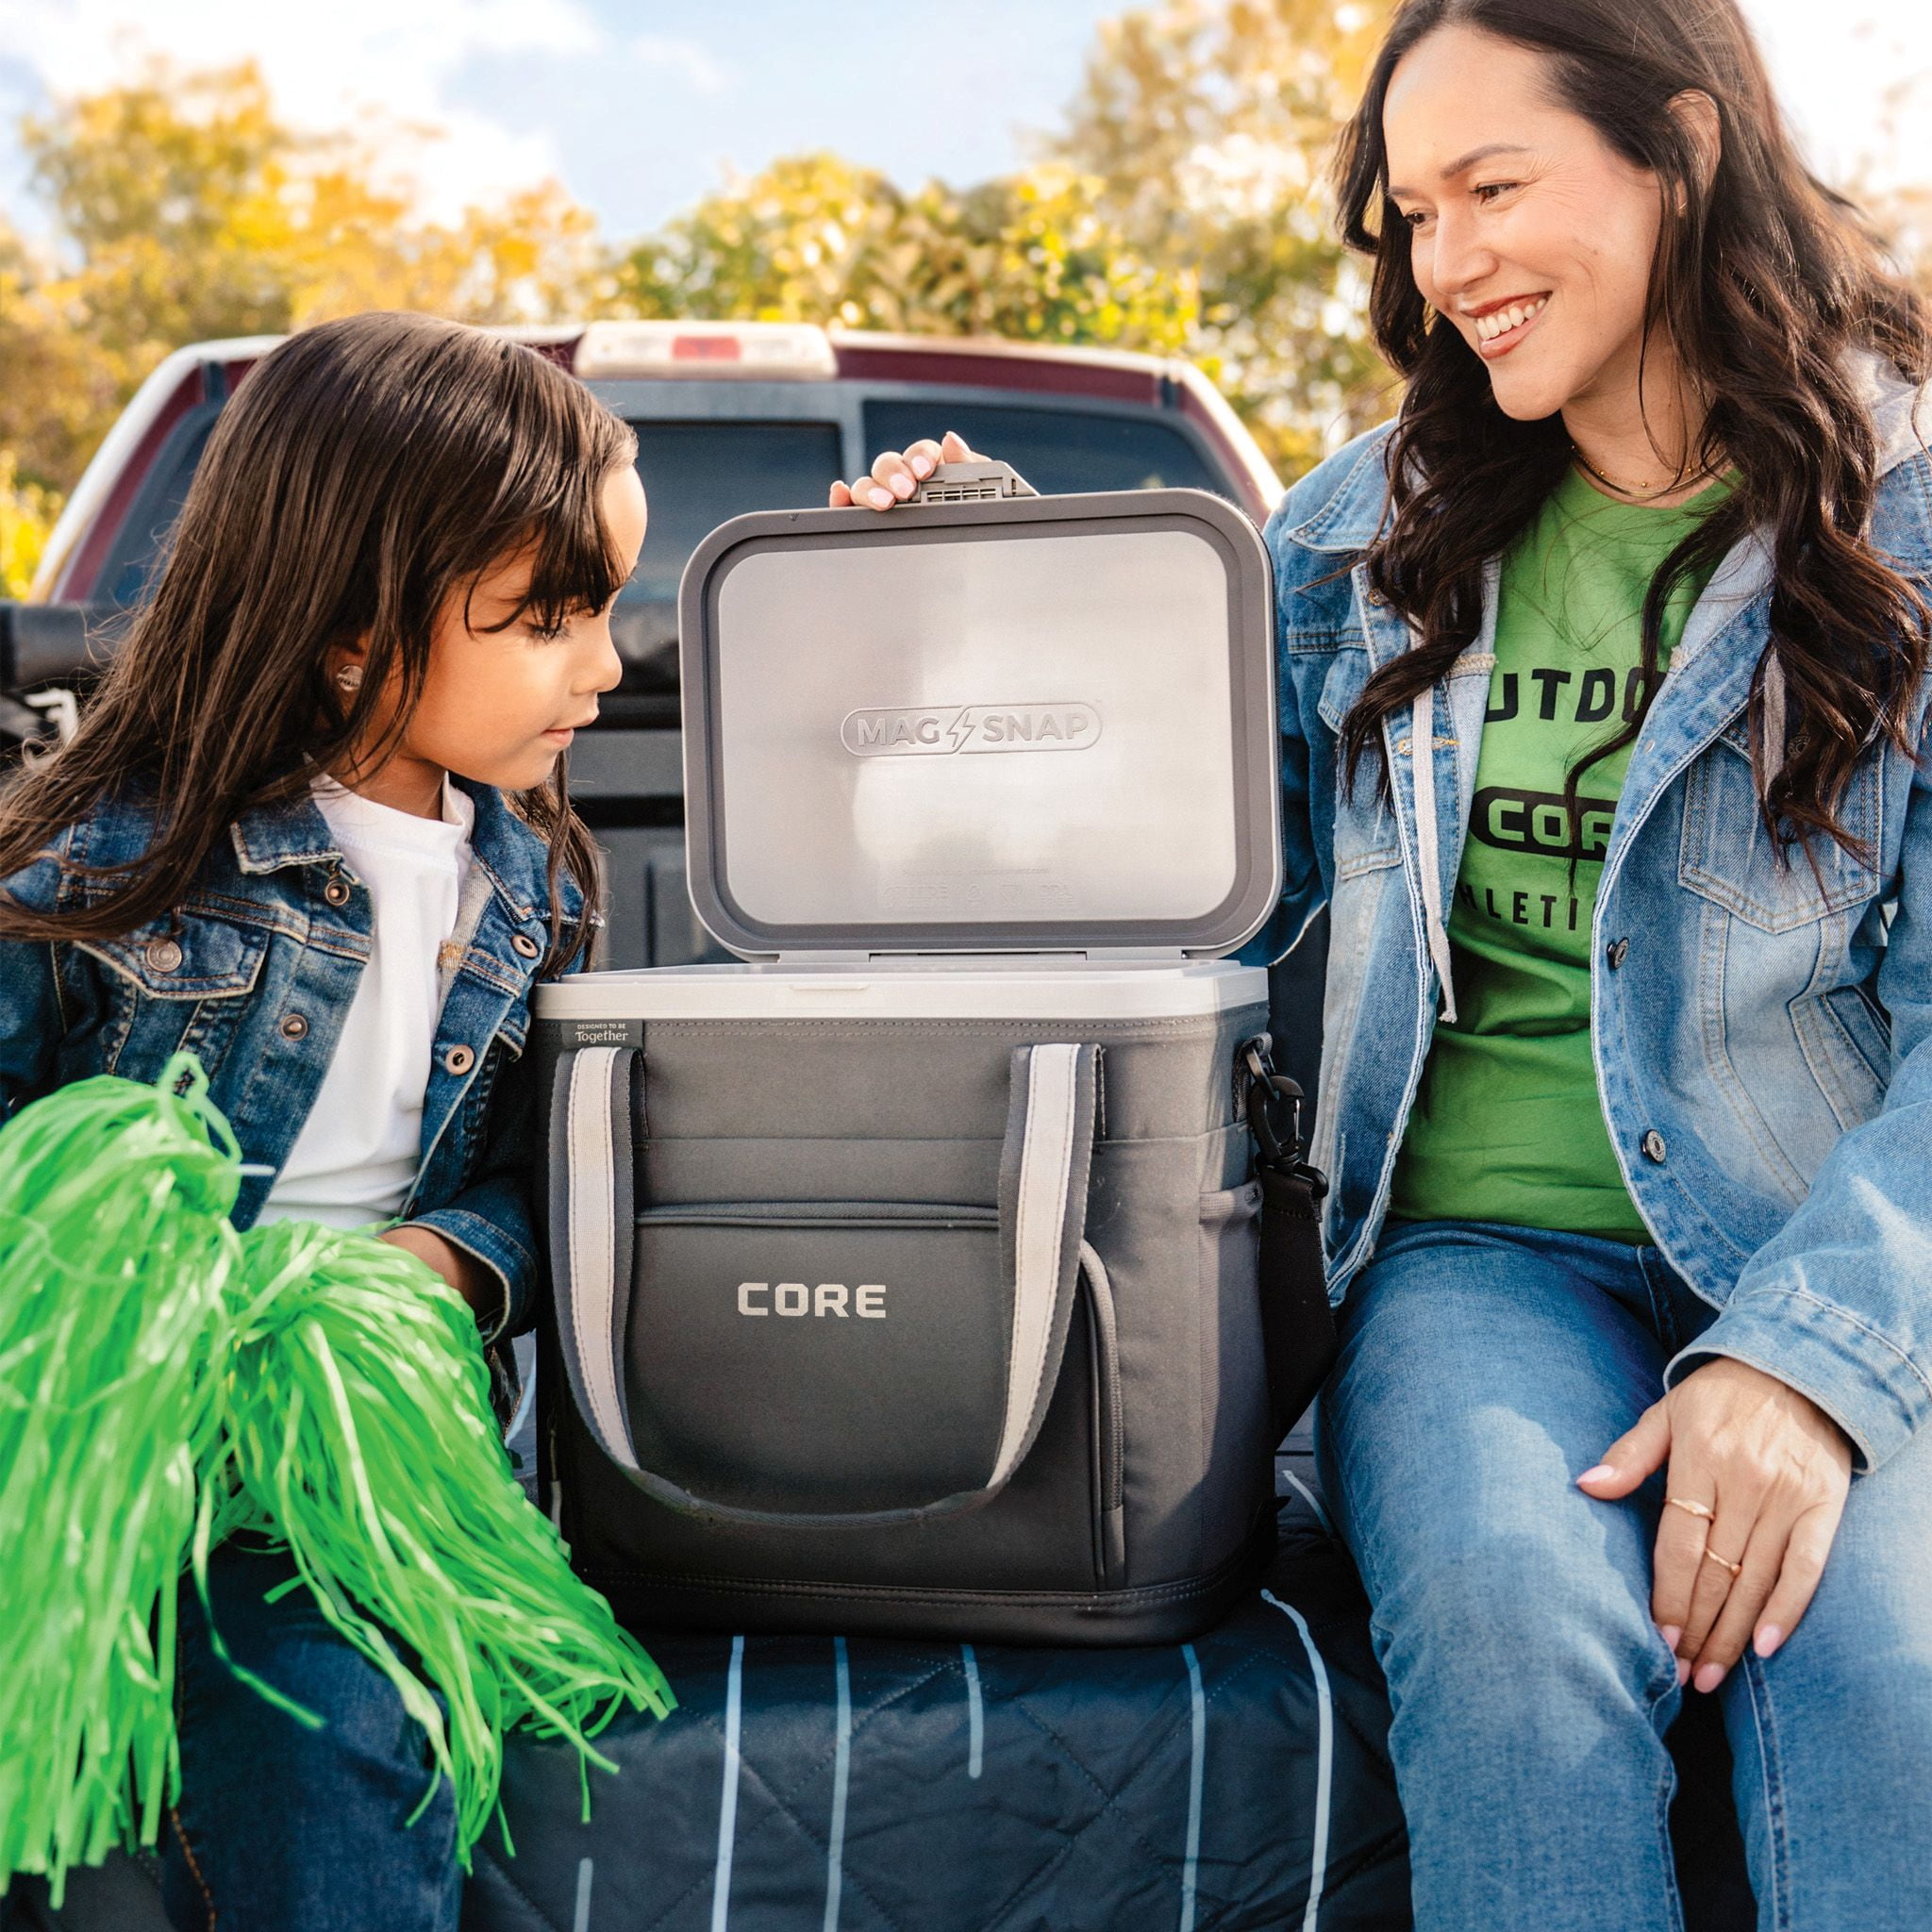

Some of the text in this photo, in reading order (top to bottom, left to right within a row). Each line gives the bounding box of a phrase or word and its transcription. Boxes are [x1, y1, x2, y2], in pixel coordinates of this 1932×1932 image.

[1484, 666, 1667, 724] UTDO
[857, 713, 1089, 746] MAG SNAP
[1457, 883, 1596, 931] HLETI
[575, 1030, 629, 1043] Together
[738, 1282, 887, 1319] CORE
